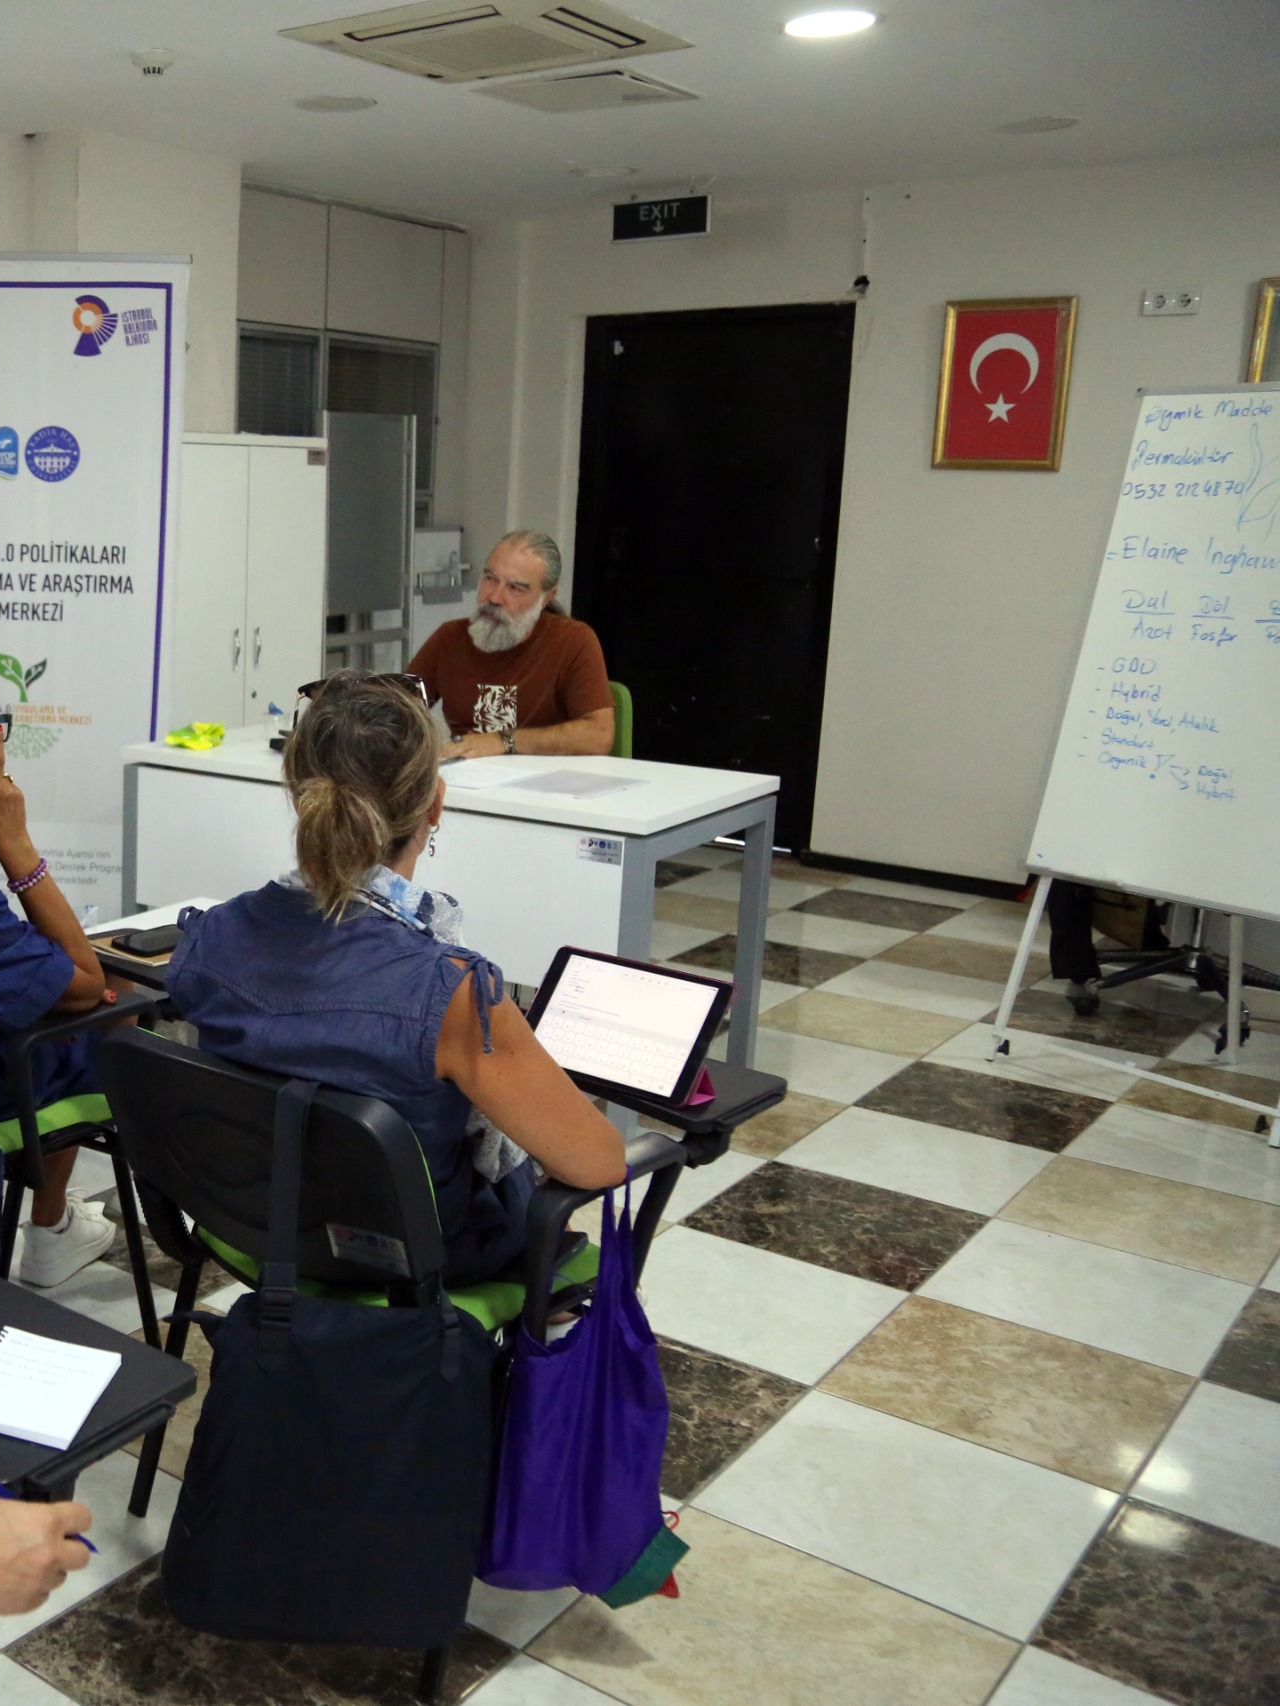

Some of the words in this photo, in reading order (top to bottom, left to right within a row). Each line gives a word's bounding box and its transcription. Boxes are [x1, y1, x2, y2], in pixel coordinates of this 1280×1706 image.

[639, 202, 680, 221] EXIT
[1213, 398, 1274, 418] Madde
[1121, 482, 1166, 500] 0532
[19, 540, 126, 565] POLİTİKALARI
[1123, 536, 1188, 565] Elaine
[18, 573, 37, 593] VE
[41, 573, 134, 597] ARAŞTIRMA
[1121, 589, 1169, 610] Dal
